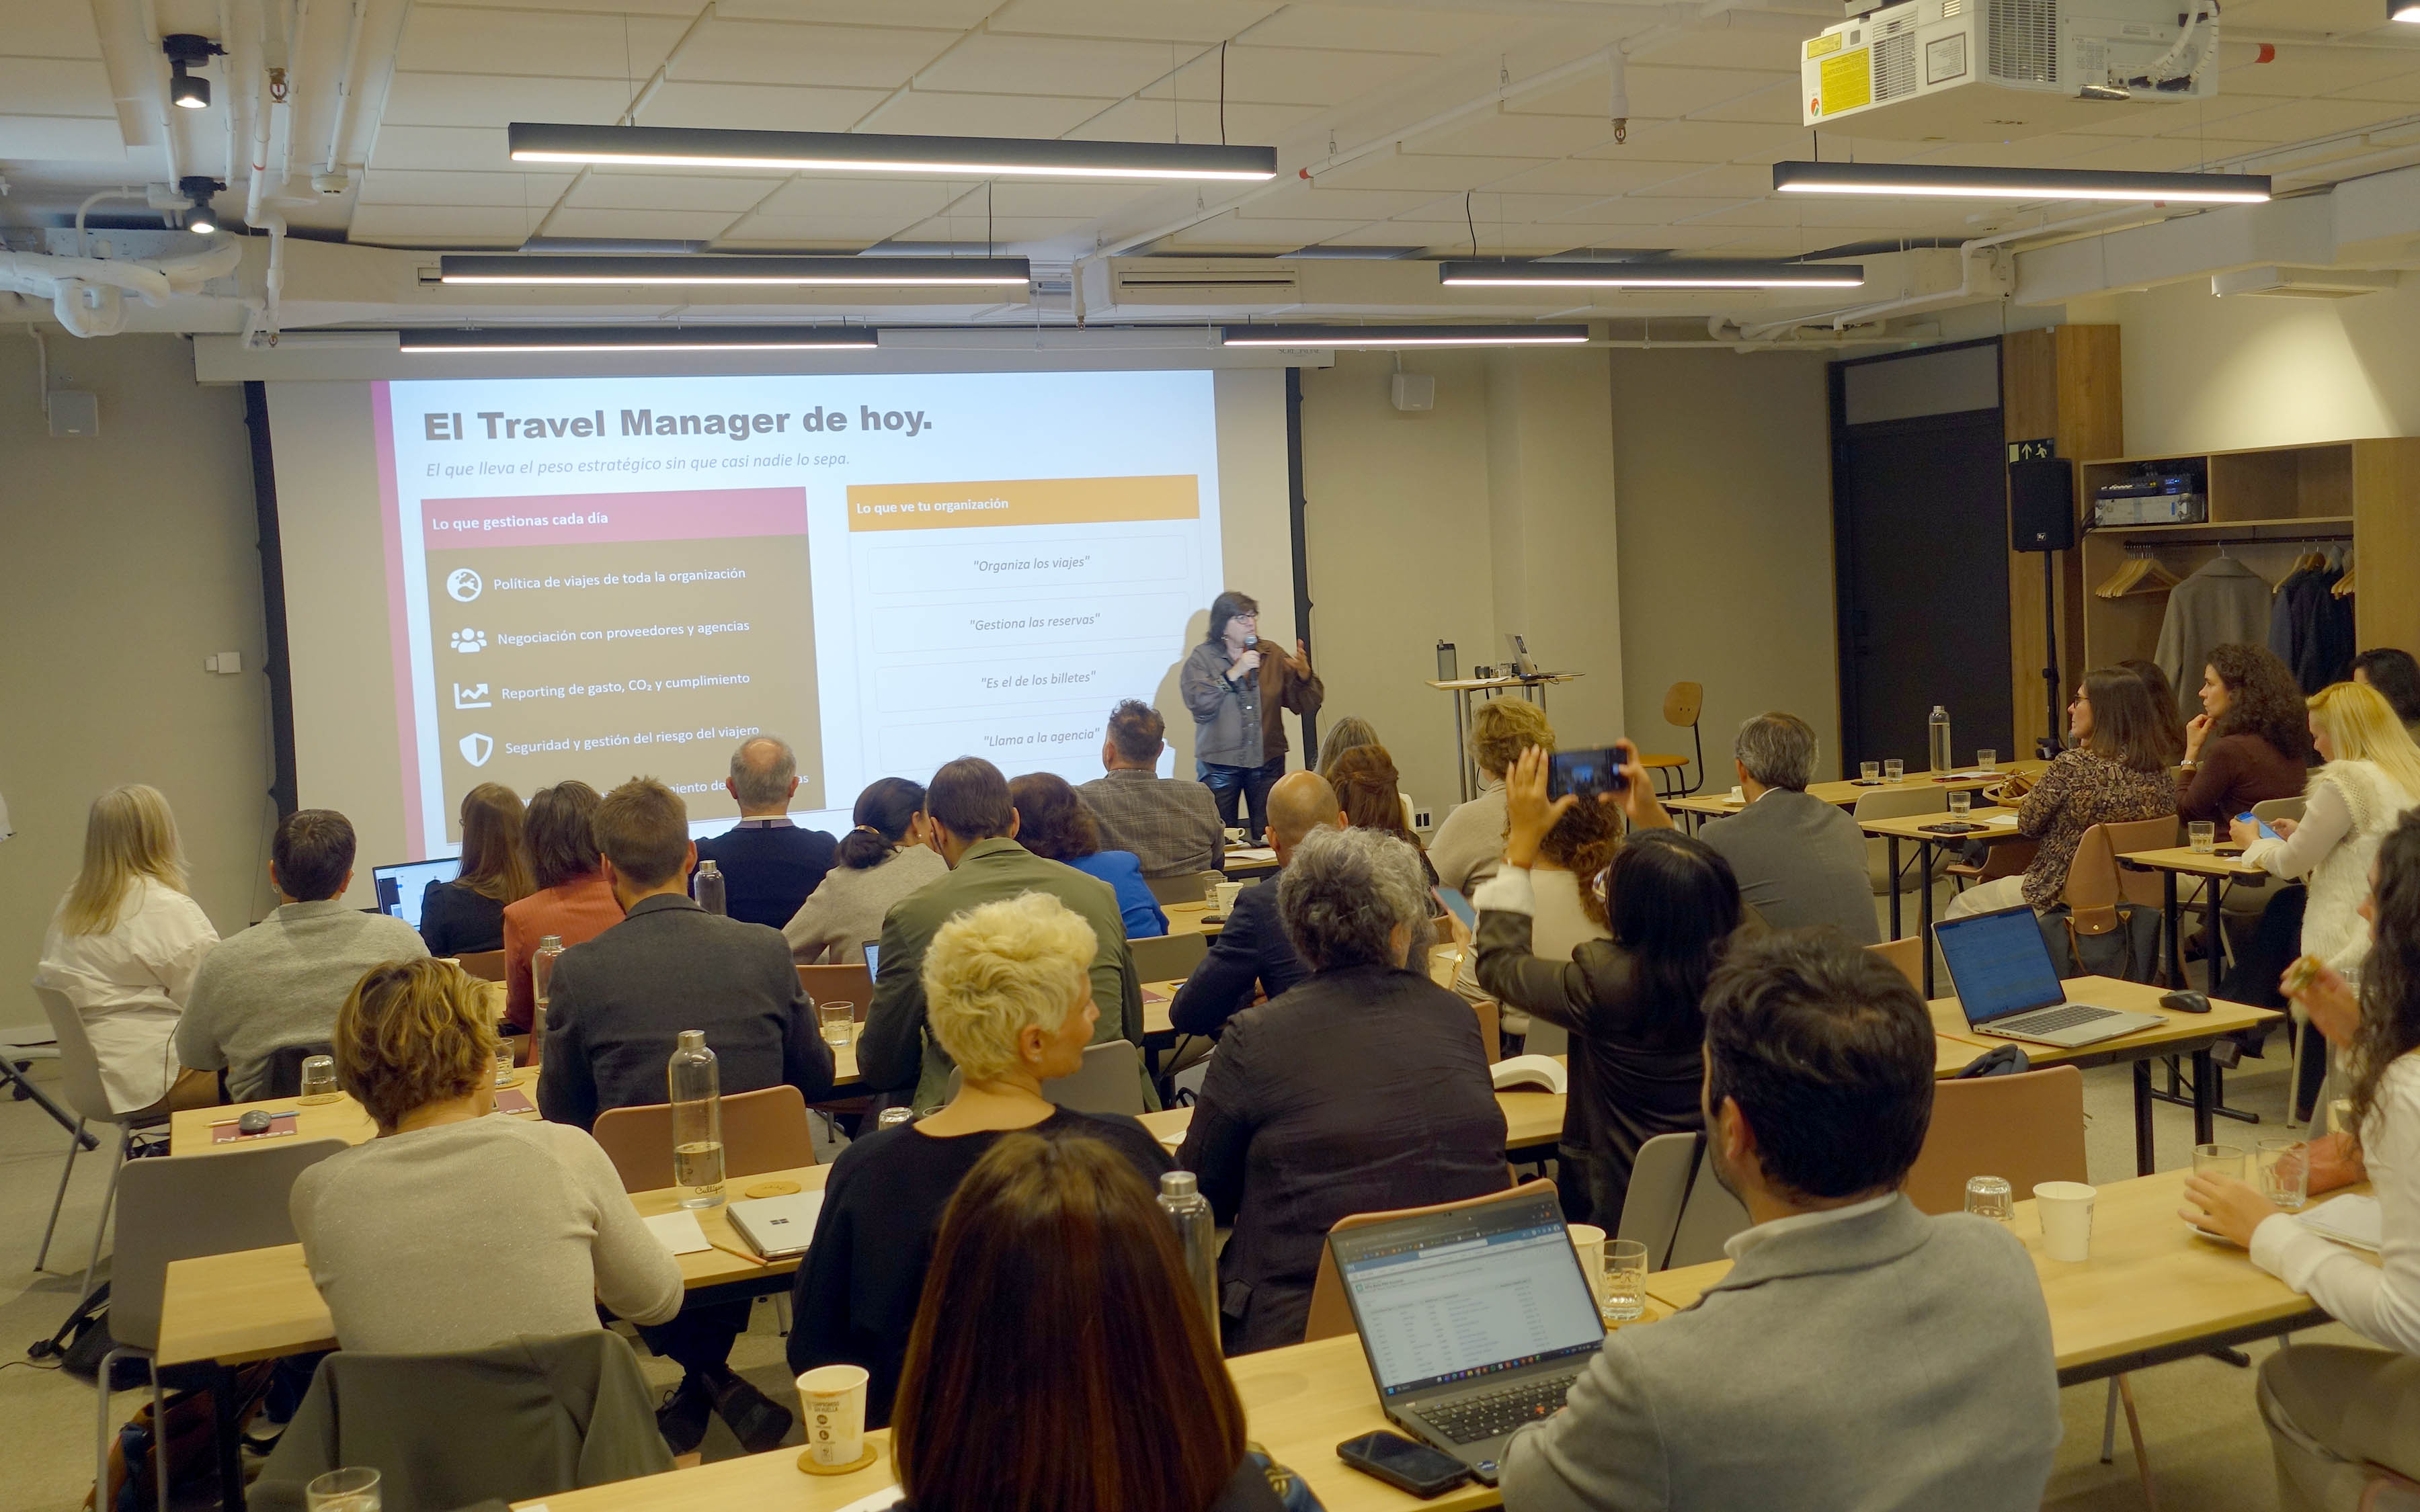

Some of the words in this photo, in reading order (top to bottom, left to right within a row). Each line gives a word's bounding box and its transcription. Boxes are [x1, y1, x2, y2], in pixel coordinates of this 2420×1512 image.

[424, 412, 463, 441] El
[477, 409, 606, 439] Travel
[620, 409, 791, 442] Manager
[803, 405, 848, 433] de
[860, 405, 932, 437] hoy.
[426, 462, 440, 477] El
[445, 465, 474, 479] que
[479, 461, 515, 475] lleva
[520, 460, 533, 474] el
[537, 462, 573, 476] peso
[577, 457, 661, 474] estratégico
[666, 456, 686, 470] sin
[690, 458, 717, 472] que
[721, 454, 750, 468] casi
[753, 453, 793, 467] nadie
[797, 452, 809, 466] lo
[813, 454, 850, 468] sepa.
[856, 503, 871, 514] Lo
[874, 504, 897, 515] que
[899, 503, 915, 512] ve
[917, 501, 931, 511] tu
[934, 498, 1009, 513] organización
[432, 518, 449, 530] Lo
[452, 519, 479, 532] que
[483, 515, 549, 531] gestionas
[552, 512, 584, 526] cada
[588, 511, 608, 524] día
[973, 559, 1031, 574] "Organiza
[1033, 557, 1049, 569] los
[1052, 555, 1090, 571] viajes"
[494, 577, 540, 590] Política
[544, 576, 561, 587] de
[563, 575, 600, 589] viajes
[603, 573, 619, 585] de
[622, 572, 651, 584] toda
[655, 571, 666, 582] la
[669, 567, 745, 584] organización
[970, 618, 1026, 631] "Gestiona
[1028, 616, 1045, 628] las
[1047, 612, 1100, 627] reservas"
[497, 630, 576, 646] Negociación
[580, 631, 603, 640] con
[606, 624, 684, 641] proveedores
[686, 626, 694, 636] y
[697, 620, 750, 636] agencias
[501, 685, 565, 702] Reporting
[569, 683, 584, 695] de
[588, 682, 625, 696] gasto,
[655, 681, 662, 691] y
[665, 673, 750, 689] cumplimiento
[981, 677, 999, 689] "Es
[1002, 675, 1012, 687] el
[1015, 675, 1029, 687] de
[1032, 674, 1048, 686] los
[1051, 670, 1096, 684] billetes"
[506, 738, 570, 755] Seguridad
[573, 740, 581, 751] y
[584, 734, 630, 751] gestión
[633, 731, 652, 744] del
[656, 731, 693, 743] riesgo
[696, 726, 715, 739] del
[717, 726, 759, 739] viajero
[984, 734, 1024, 747] "Llama
[1026, 736, 1034, 744] a
[1037, 732, 1047, 743] la
[1050, 728, 1100, 743] agencia"
